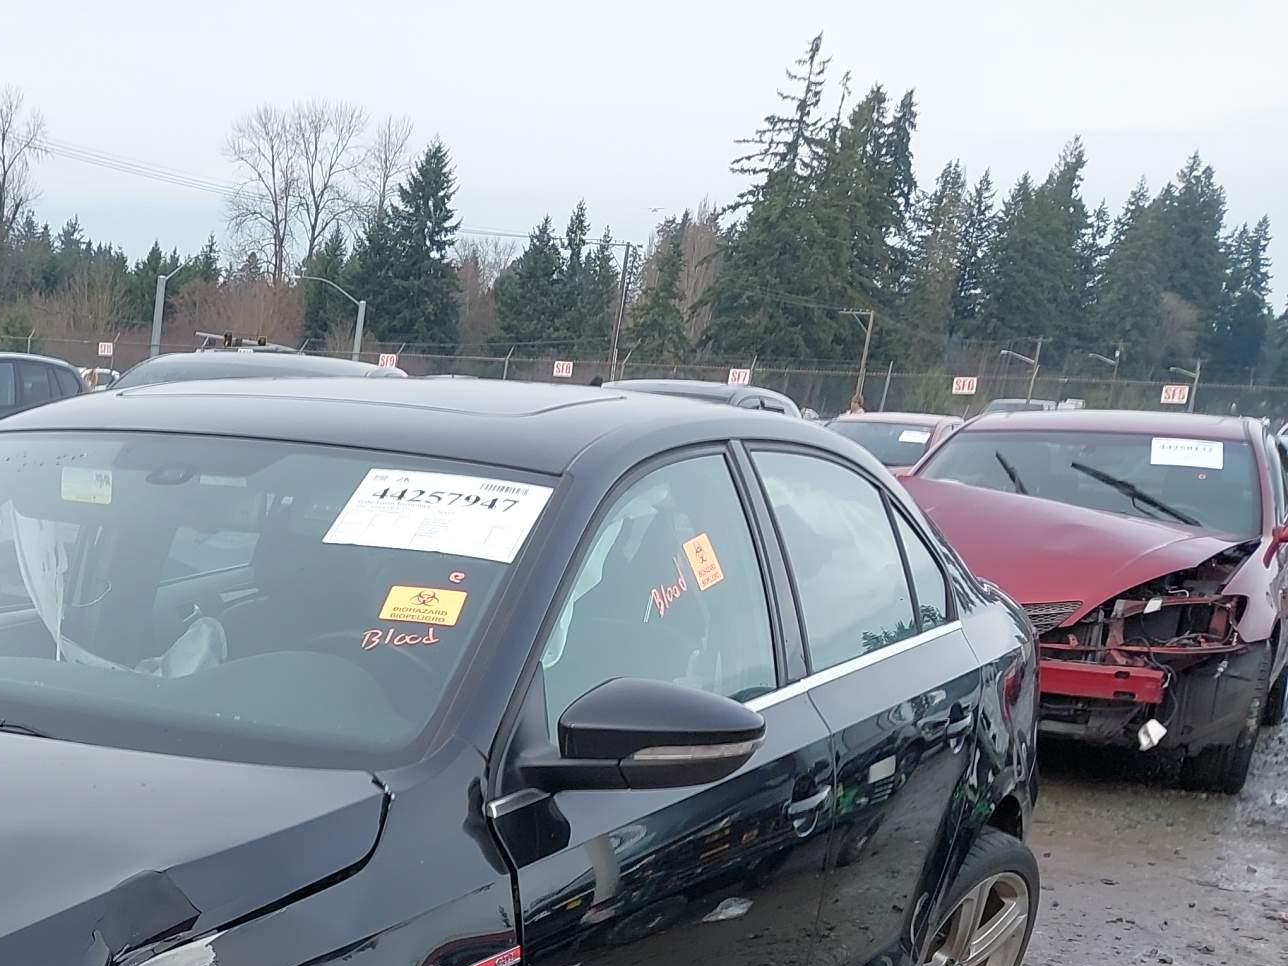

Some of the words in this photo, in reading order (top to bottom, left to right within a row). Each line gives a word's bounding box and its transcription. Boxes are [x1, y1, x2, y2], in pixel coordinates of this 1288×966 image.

[372, 487, 519, 512] 44257947
[646, 556, 688, 619] Blood
[390, 613, 446, 623] BIOPELIGRO
[392, 606, 448, 616] BIOHAZARD
[361, 627, 440, 650] Blood
